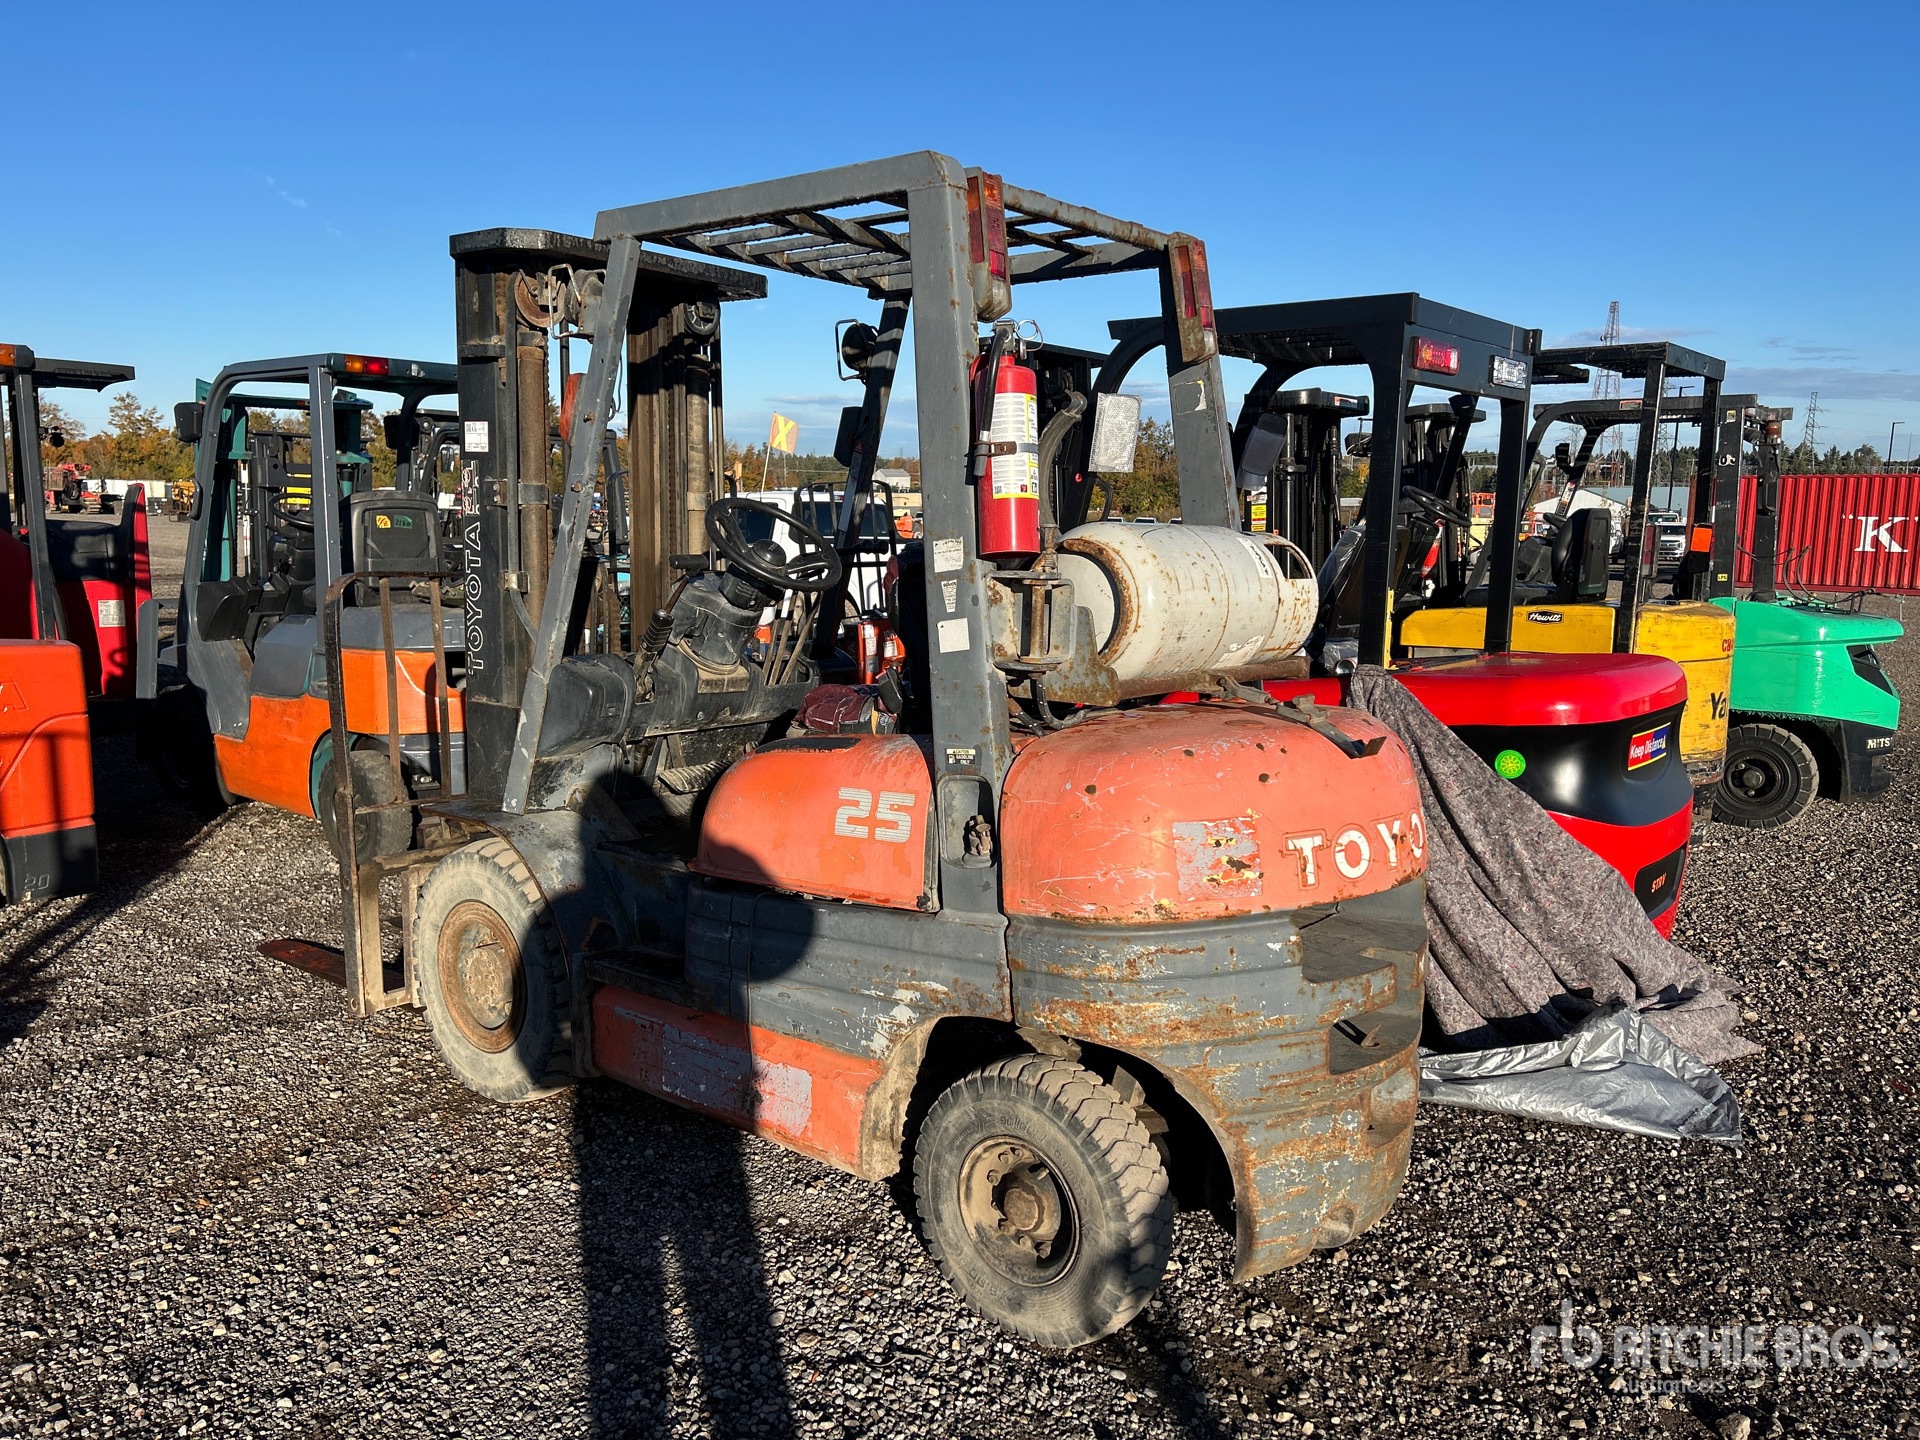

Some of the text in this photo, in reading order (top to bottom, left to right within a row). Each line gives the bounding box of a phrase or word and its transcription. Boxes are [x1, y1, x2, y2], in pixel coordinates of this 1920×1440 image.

[464, 522, 484, 676] TOYOTA
[1529, 612, 1562, 622] Hewitt
[1630, 738, 1663, 759] Keep Distance
[834, 786, 916, 844] 25
[1286, 811, 1424, 888] TOYO
